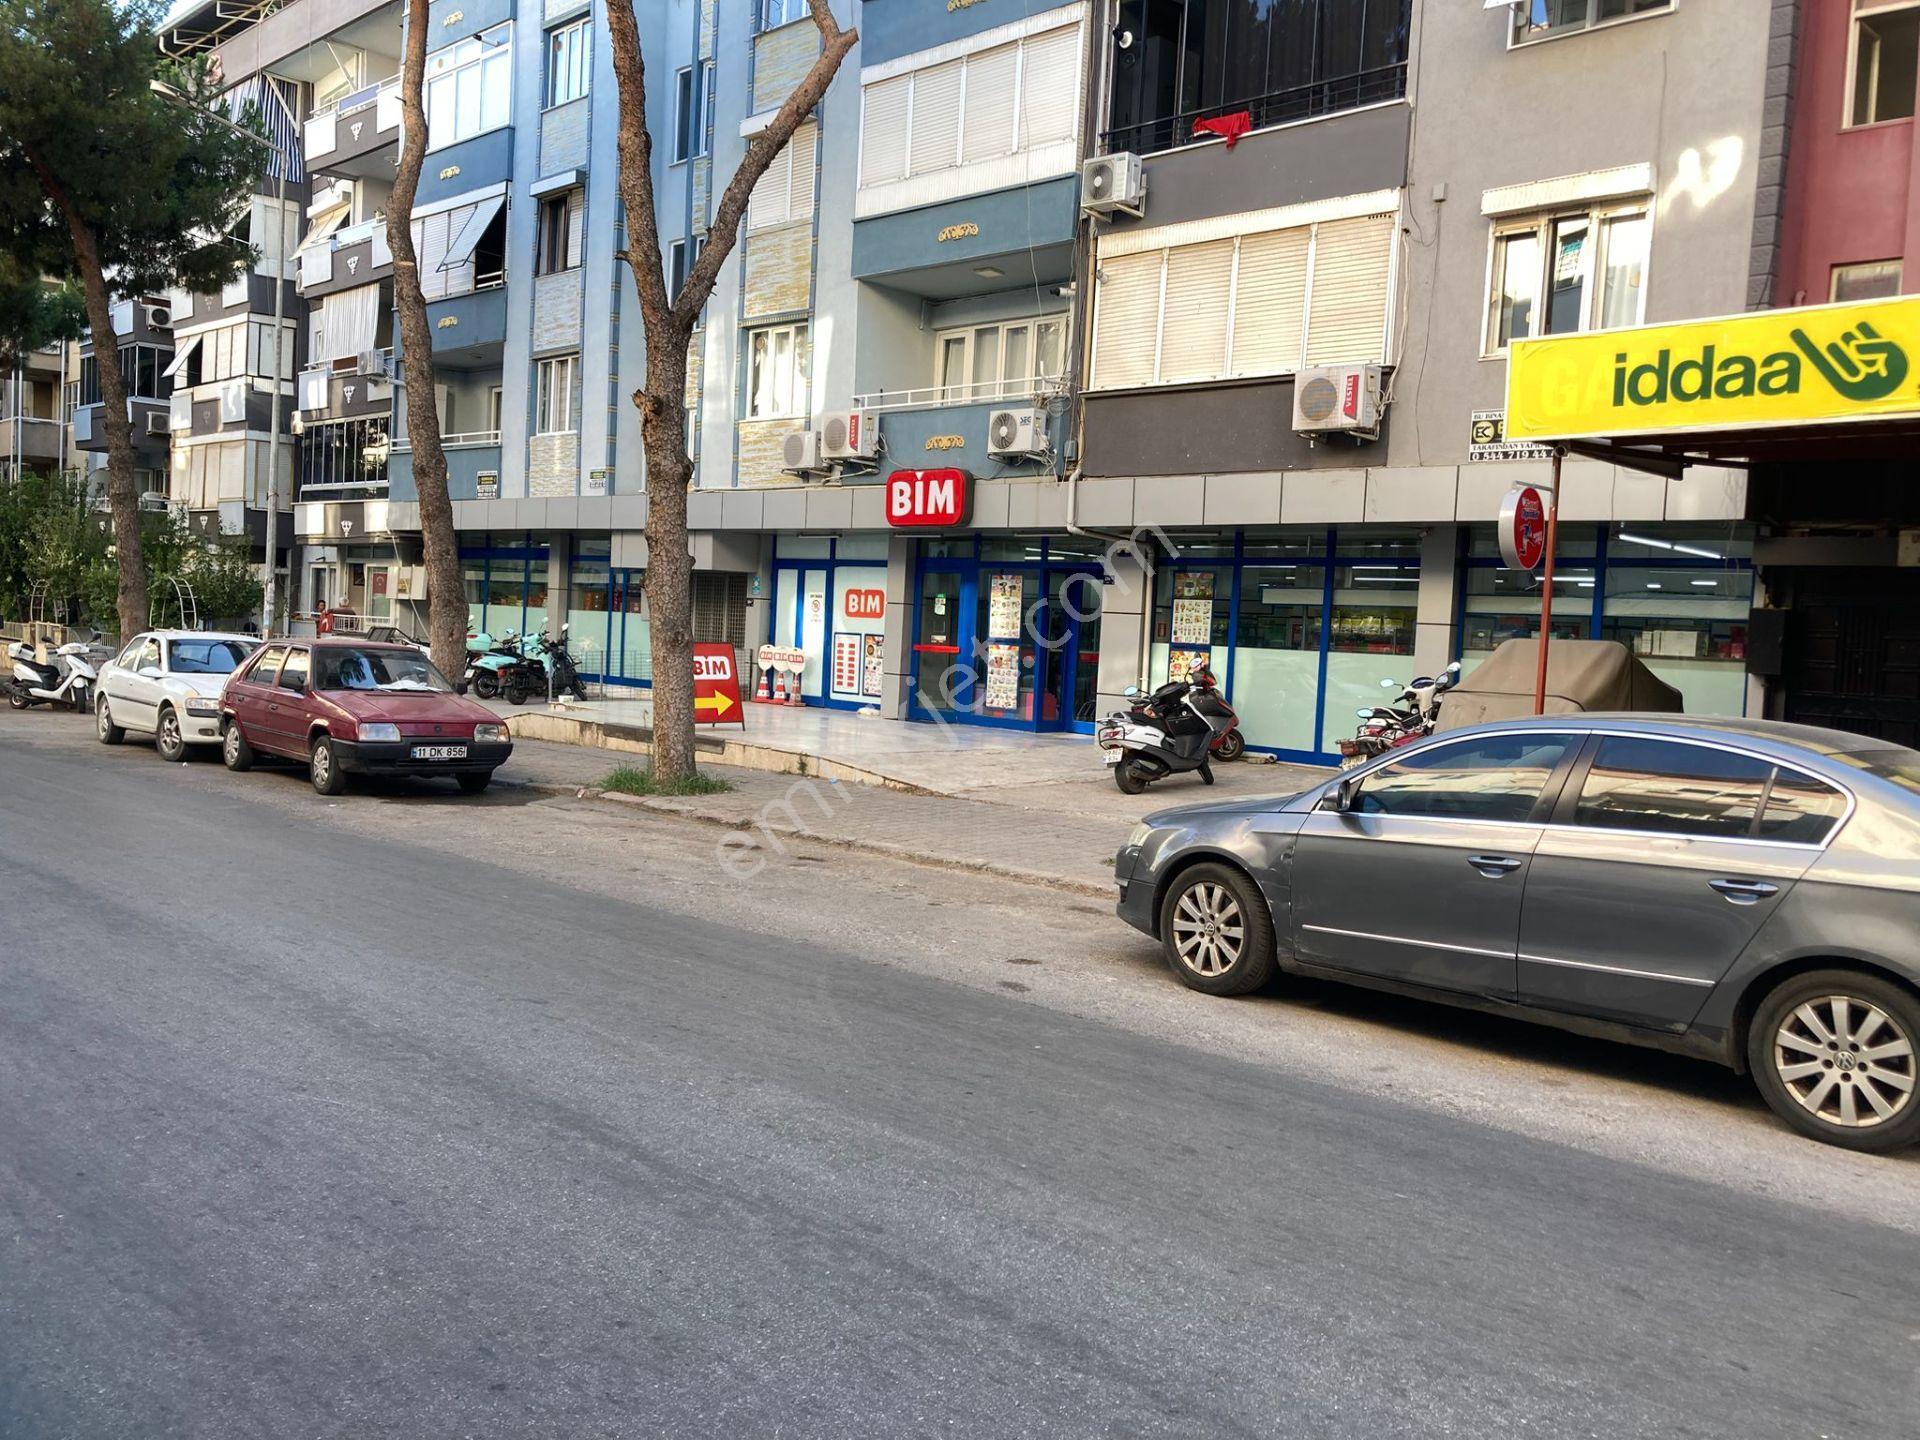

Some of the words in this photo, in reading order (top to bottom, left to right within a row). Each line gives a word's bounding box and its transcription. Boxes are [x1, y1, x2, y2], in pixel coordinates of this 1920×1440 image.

[1612, 345, 1800, 407] iddaa
[1472, 452, 1480, 461] 0
[1483, 451, 1504, 460] 544
[1508, 450, 1529, 460] 719
[418, 748, 426, 757] 11
[430, 748, 443, 757] DK
[446, 748, 463, 757] 856
